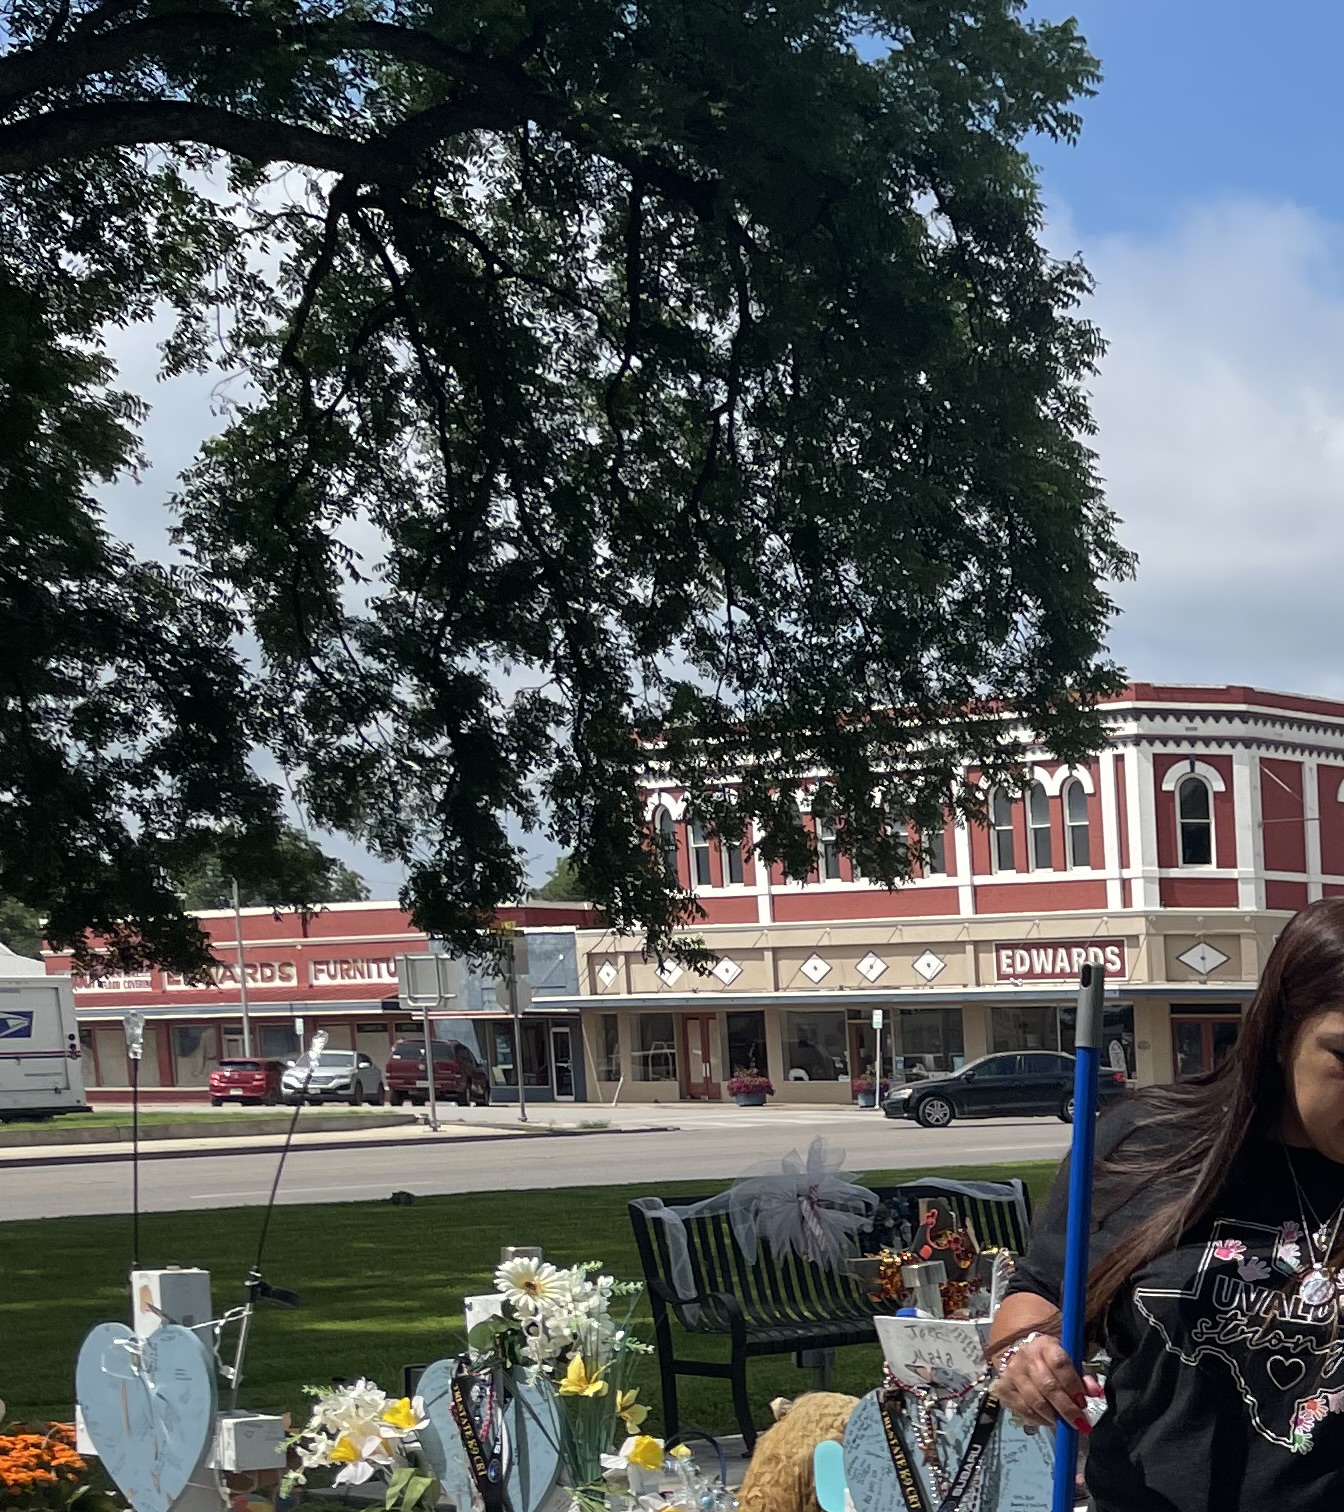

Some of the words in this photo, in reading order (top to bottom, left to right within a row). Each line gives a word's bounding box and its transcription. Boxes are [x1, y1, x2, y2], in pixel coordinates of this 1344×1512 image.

[167, 962, 296, 987] EWARDS
[313, 957, 397, 981] FURNITU
[1000, 945, 1122, 975] EDWARDS
[951, 1443, 983, 1498] SUBARU
